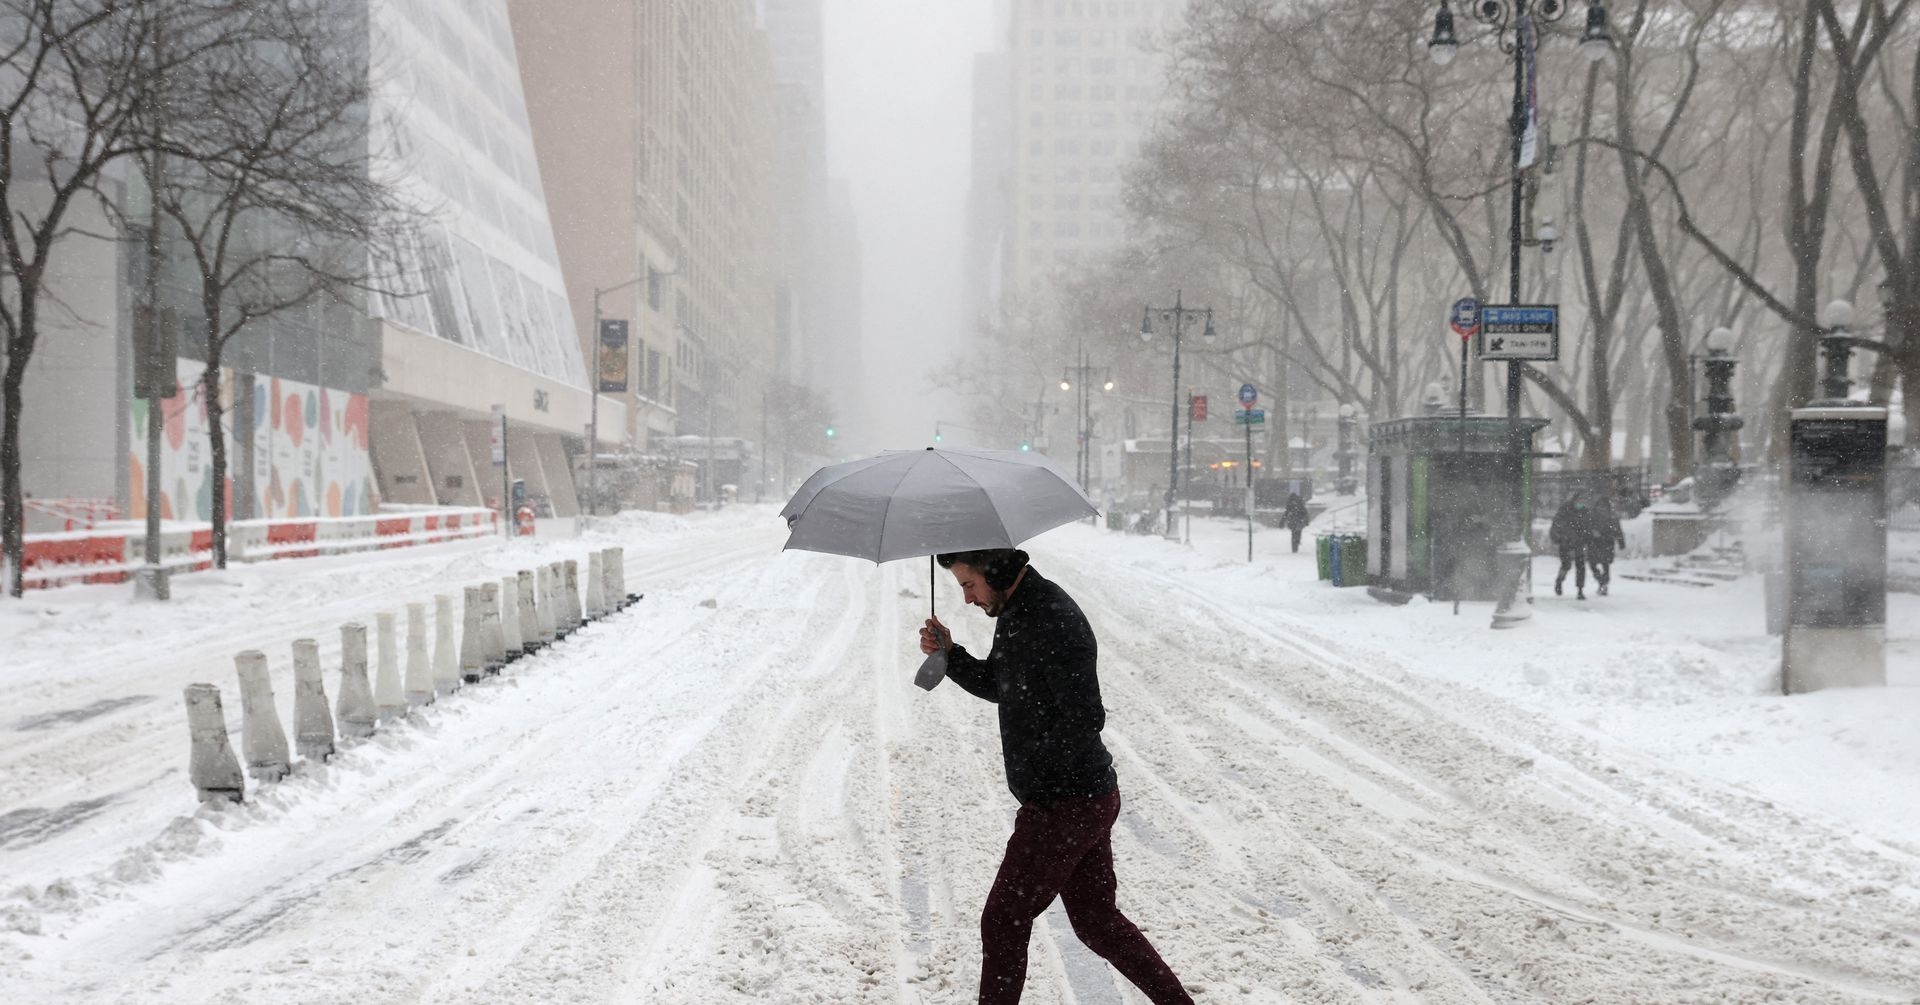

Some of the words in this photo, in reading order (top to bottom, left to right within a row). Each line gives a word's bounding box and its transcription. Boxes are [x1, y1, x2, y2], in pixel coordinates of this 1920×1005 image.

[1501, 312, 1521, 321] BUS
[1523, 312, 1549, 320] LANE
[1487, 324, 1520, 332] BUSES
[1522, 324, 1548, 332] ONLY
